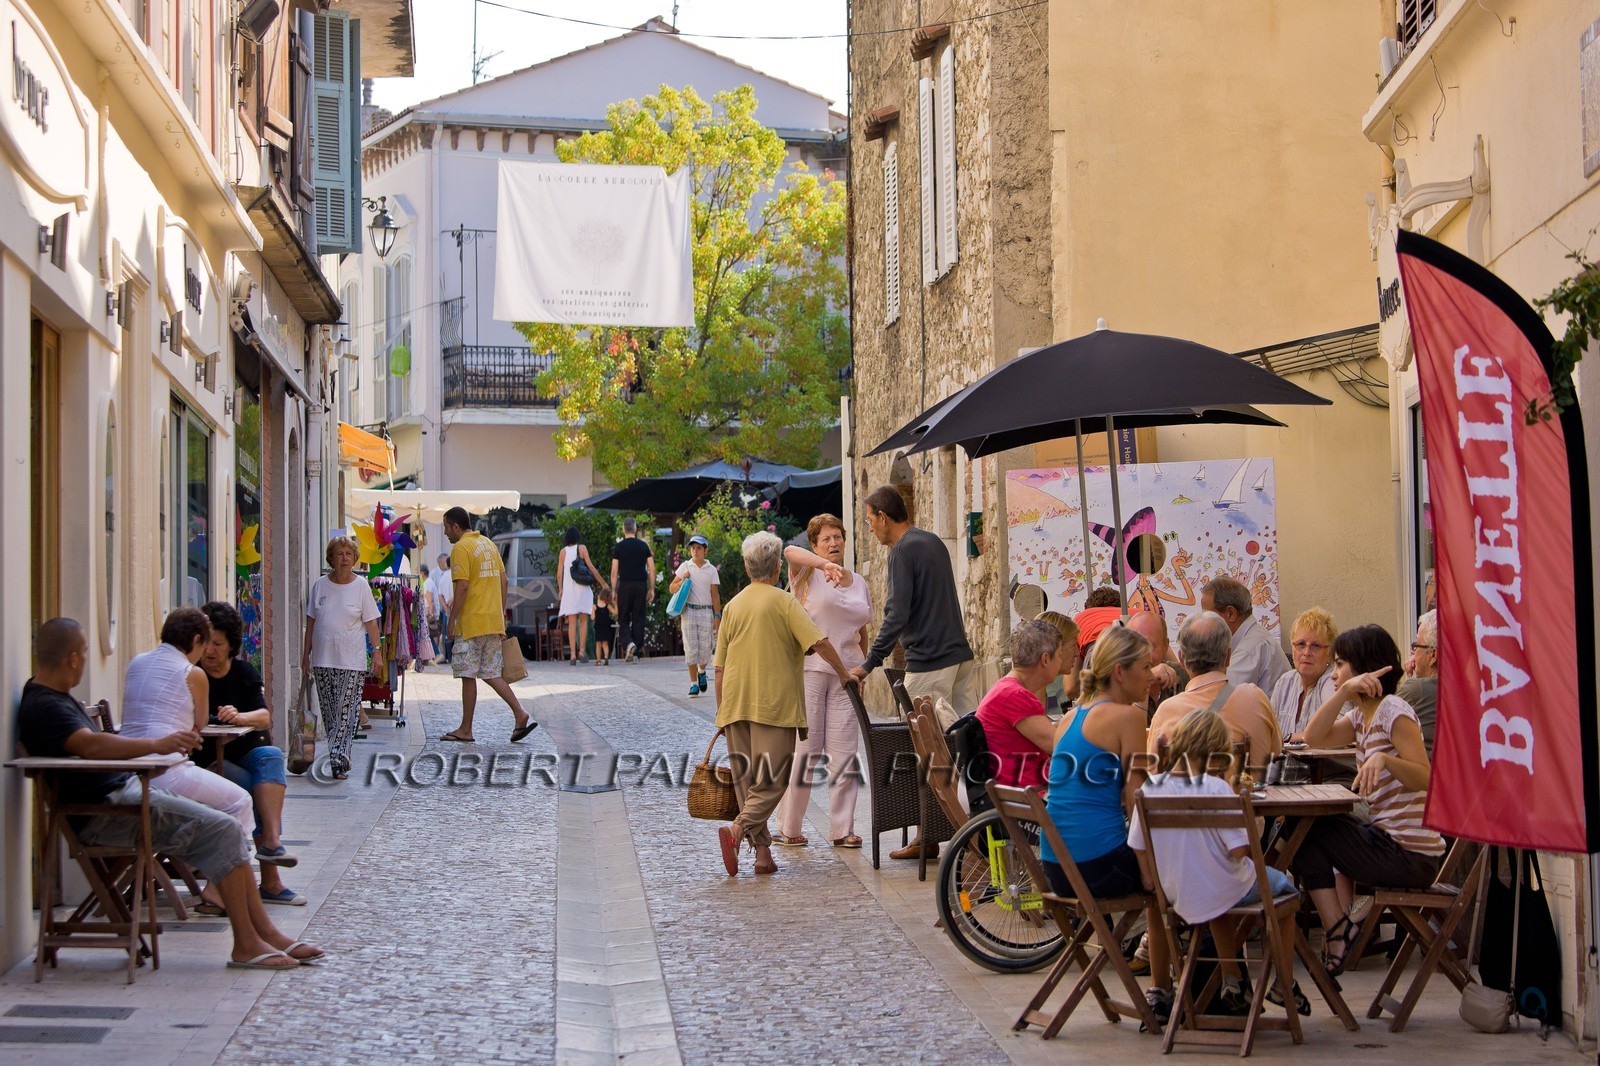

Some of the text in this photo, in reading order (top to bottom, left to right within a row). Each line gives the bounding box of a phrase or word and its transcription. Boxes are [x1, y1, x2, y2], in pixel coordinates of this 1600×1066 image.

[538, 174, 551, 183] LA
[559, 175, 597, 185] COLLE
[604, 177, 626, 186] SUR
[579, 289, 632, 299] antiquaires
[560, 299, 596, 308] ateliers
[613, 301, 650, 310] galeries
[582, 310, 627, 319] boutiques
